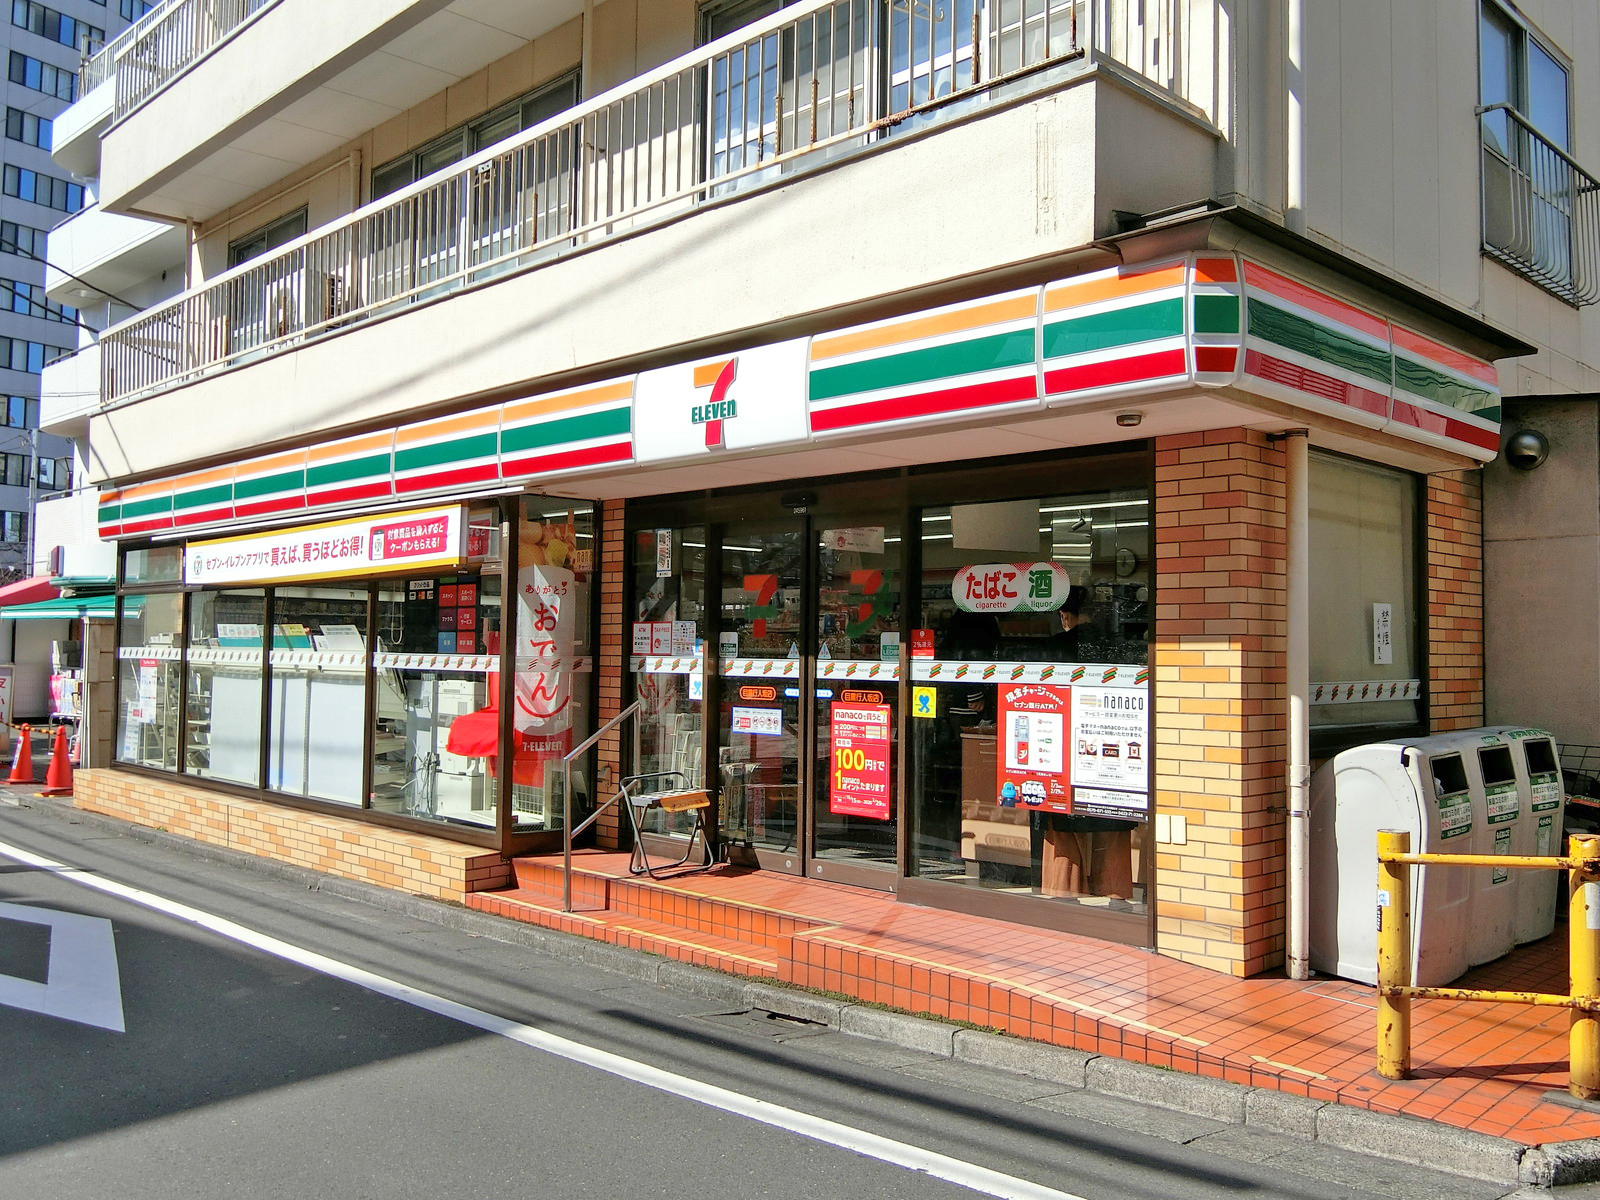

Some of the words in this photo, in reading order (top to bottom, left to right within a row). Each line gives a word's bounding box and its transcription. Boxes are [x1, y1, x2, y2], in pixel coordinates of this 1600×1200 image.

[387, 522, 444, 541] 対象商品を購入すると
[390, 537, 440, 553] クーポンもらえる!
[525, 583, 568, 595] ありがとう
[965, 570, 1018, 600] たばこ
[1028, 569, 1053, 598] 酒
[975, 601, 1007, 609] cigarette
[1031, 601, 1053, 609] liquor
[530, 602, 558, 702] おでん
[844, 692, 880, 703] 目黒行人坂店
[1005, 685, 1064, 706] 現金チャージできるのは
[1104, 695, 1144, 711] nanaco
